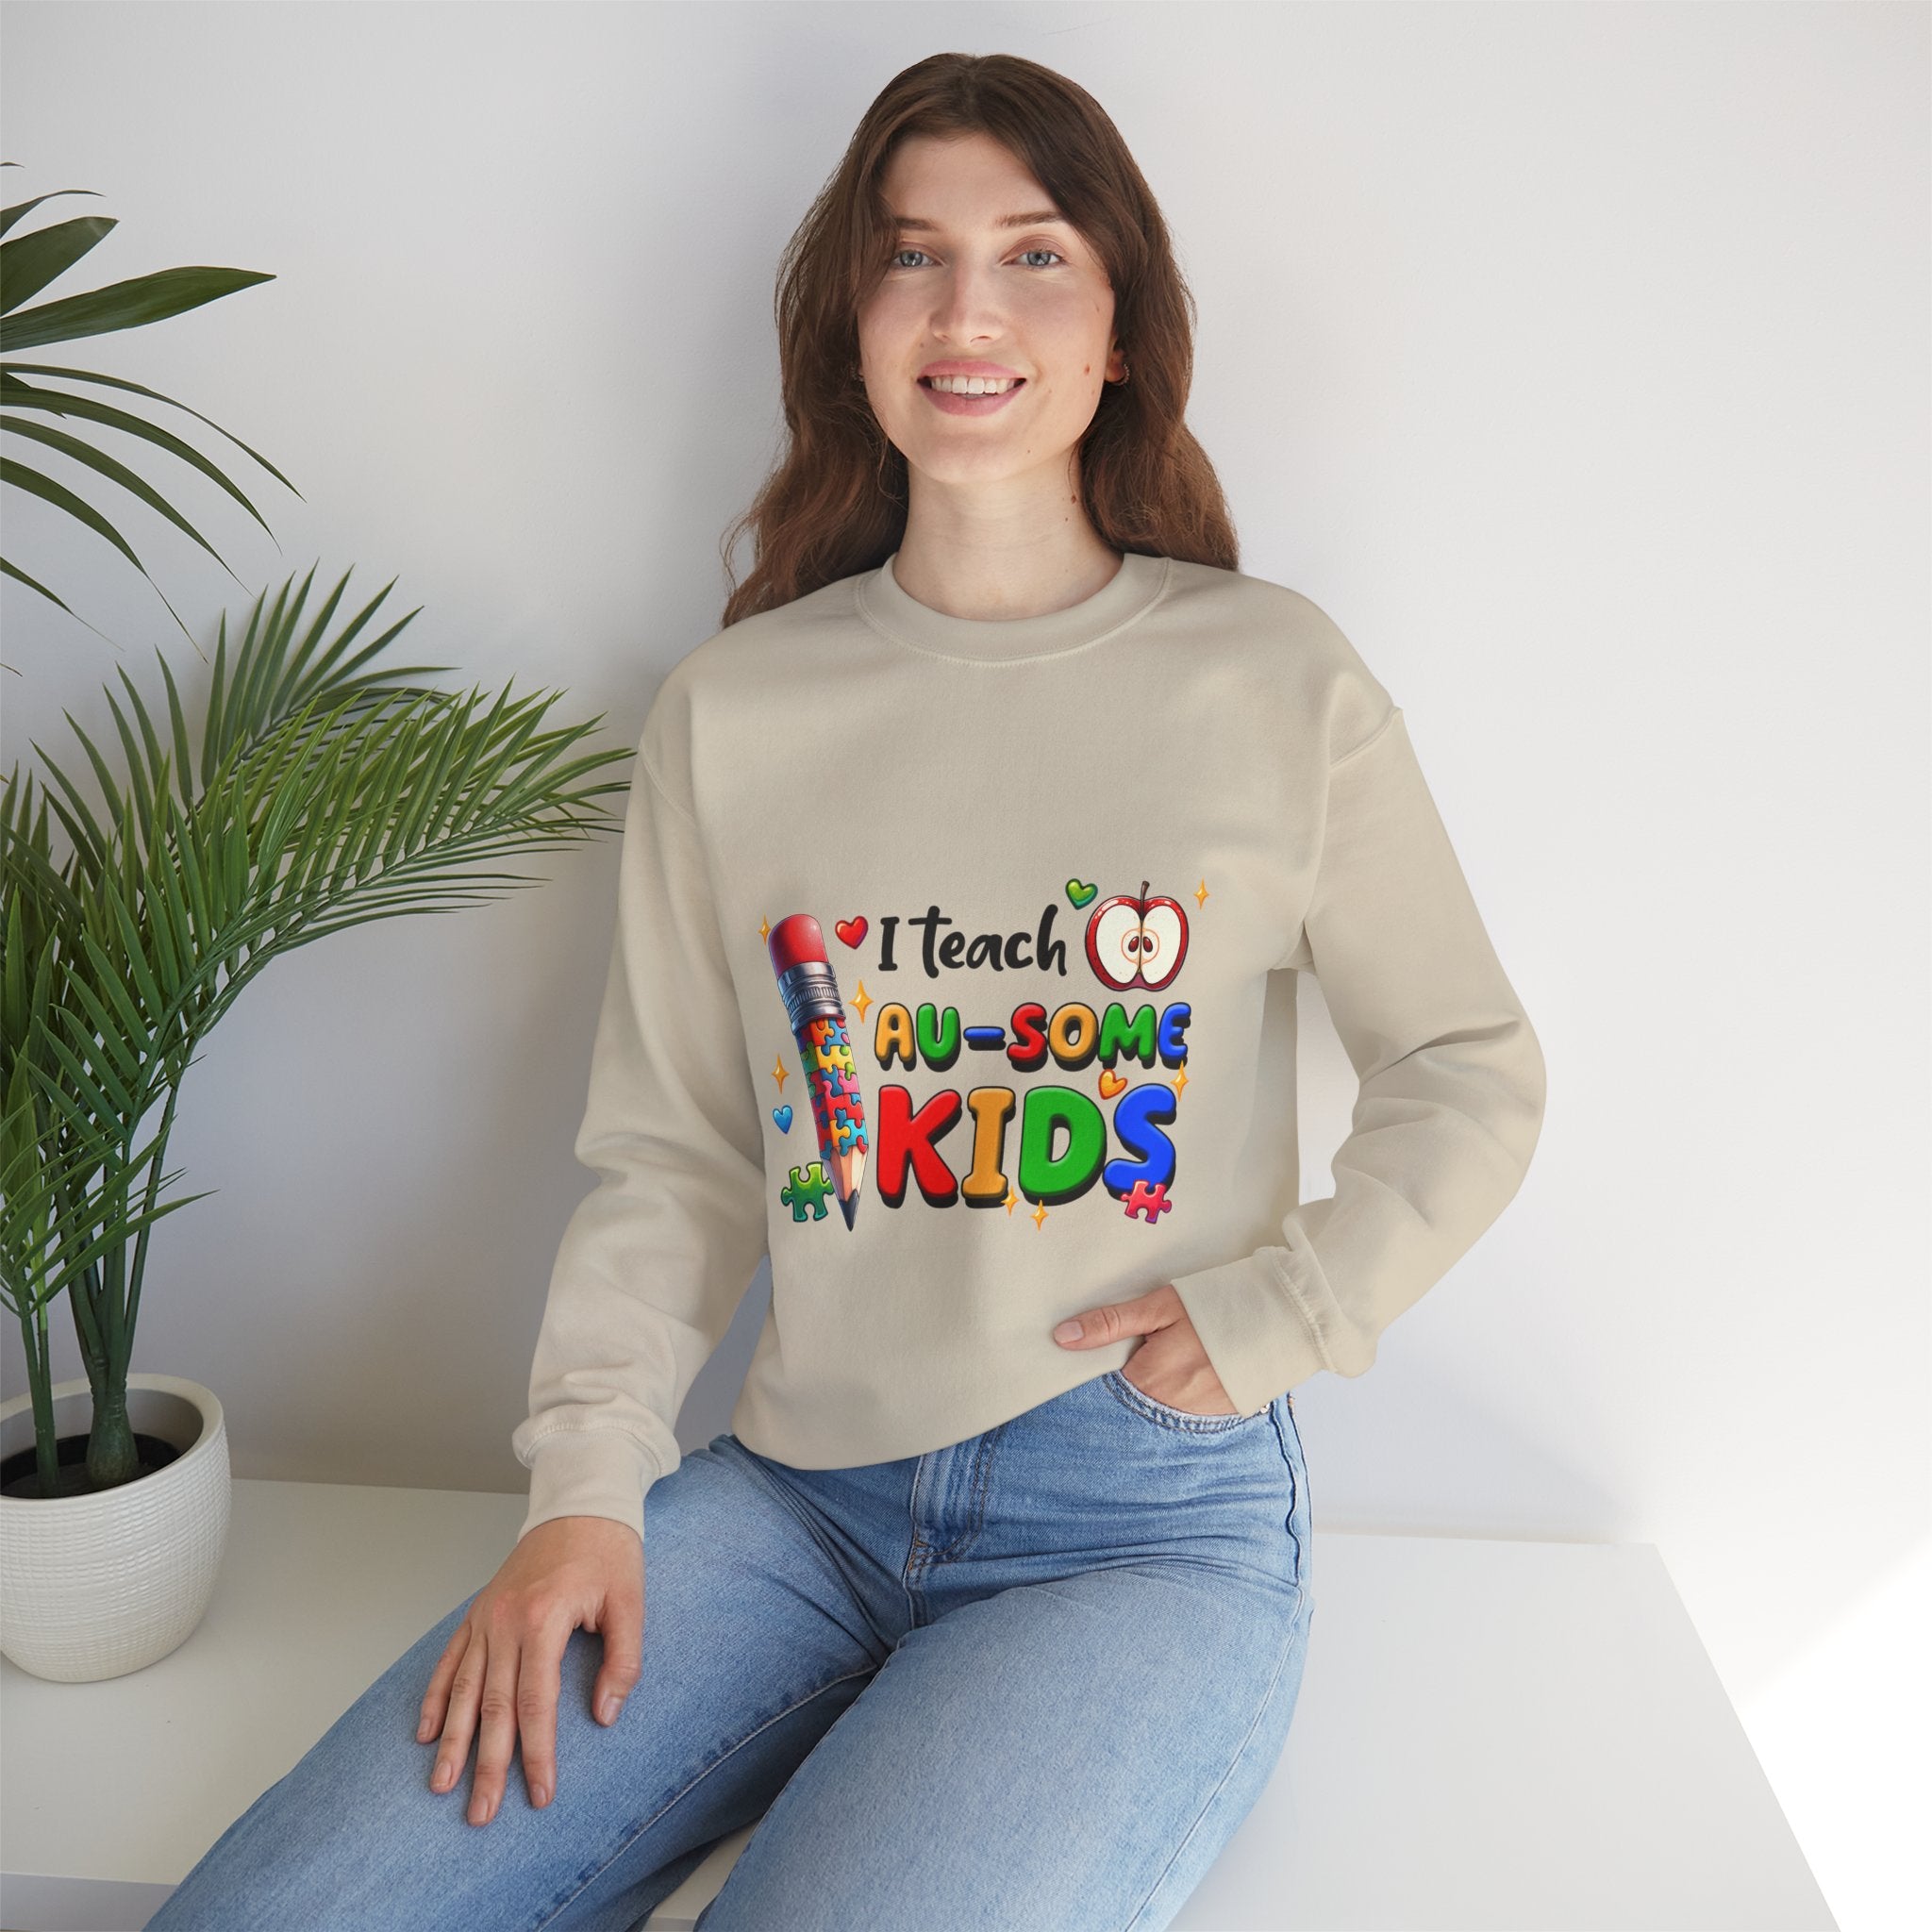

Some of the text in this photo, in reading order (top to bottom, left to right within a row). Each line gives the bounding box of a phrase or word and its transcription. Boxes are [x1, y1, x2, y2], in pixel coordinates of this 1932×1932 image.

[877, 905, 1067, 978] I teach
[874, 1002, 1191, 1072] AU-SOME
[875, 1083, 1176, 1208] KIDS
